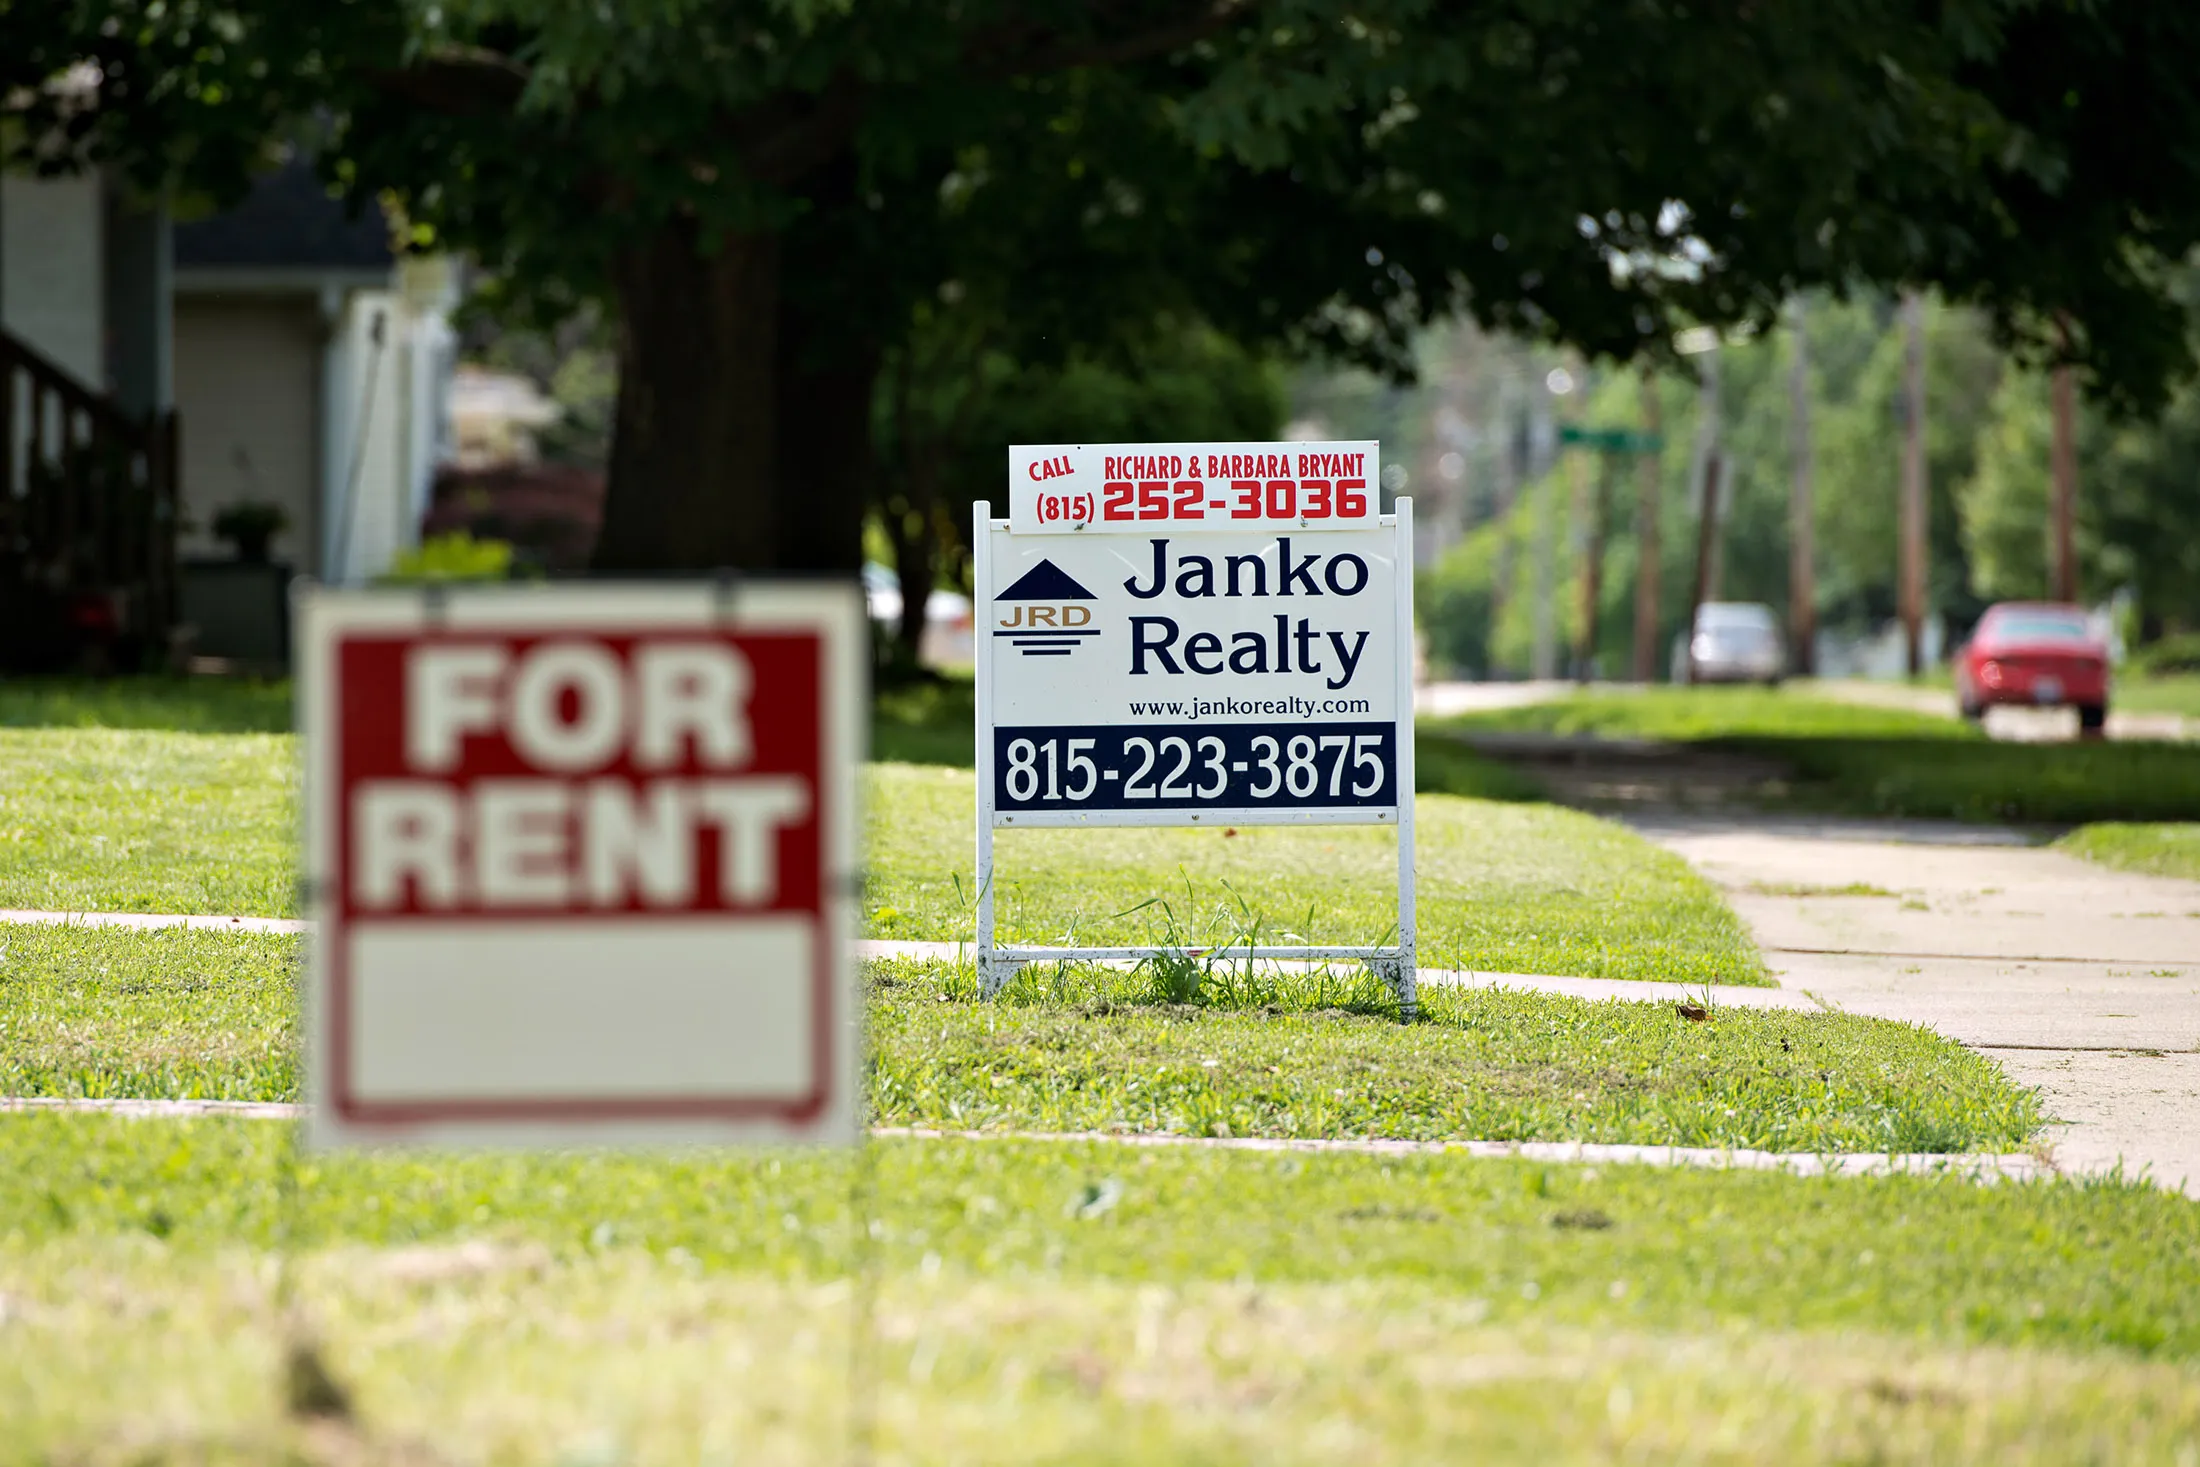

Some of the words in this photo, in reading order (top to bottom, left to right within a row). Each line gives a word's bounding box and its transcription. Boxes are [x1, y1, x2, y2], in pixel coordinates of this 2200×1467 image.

[1028, 456, 1074, 481] CALL
[1104, 455, 1183, 480] RICHARD
[1188, 455, 1202, 479] &
[1208, 454, 1291, 479] BARBARA
[1297, 453, 1365, 478] BRYANT
[1036, 492, 1095, 524] (815)
[1103, 480, 1367, 520] 252-3036
[1123, 538, 1369, 599] Janko
[999, 606, 1091, 627] JRD
[1128, 614, 1370, 690] Realty
[404, 642, 753, 771] FOR
[1128, 696, 1370, 720] www.jankorealty.com
[1005, 735, 1385, 801] 815-223-3875
[355, 779, 809, 905] RENT
